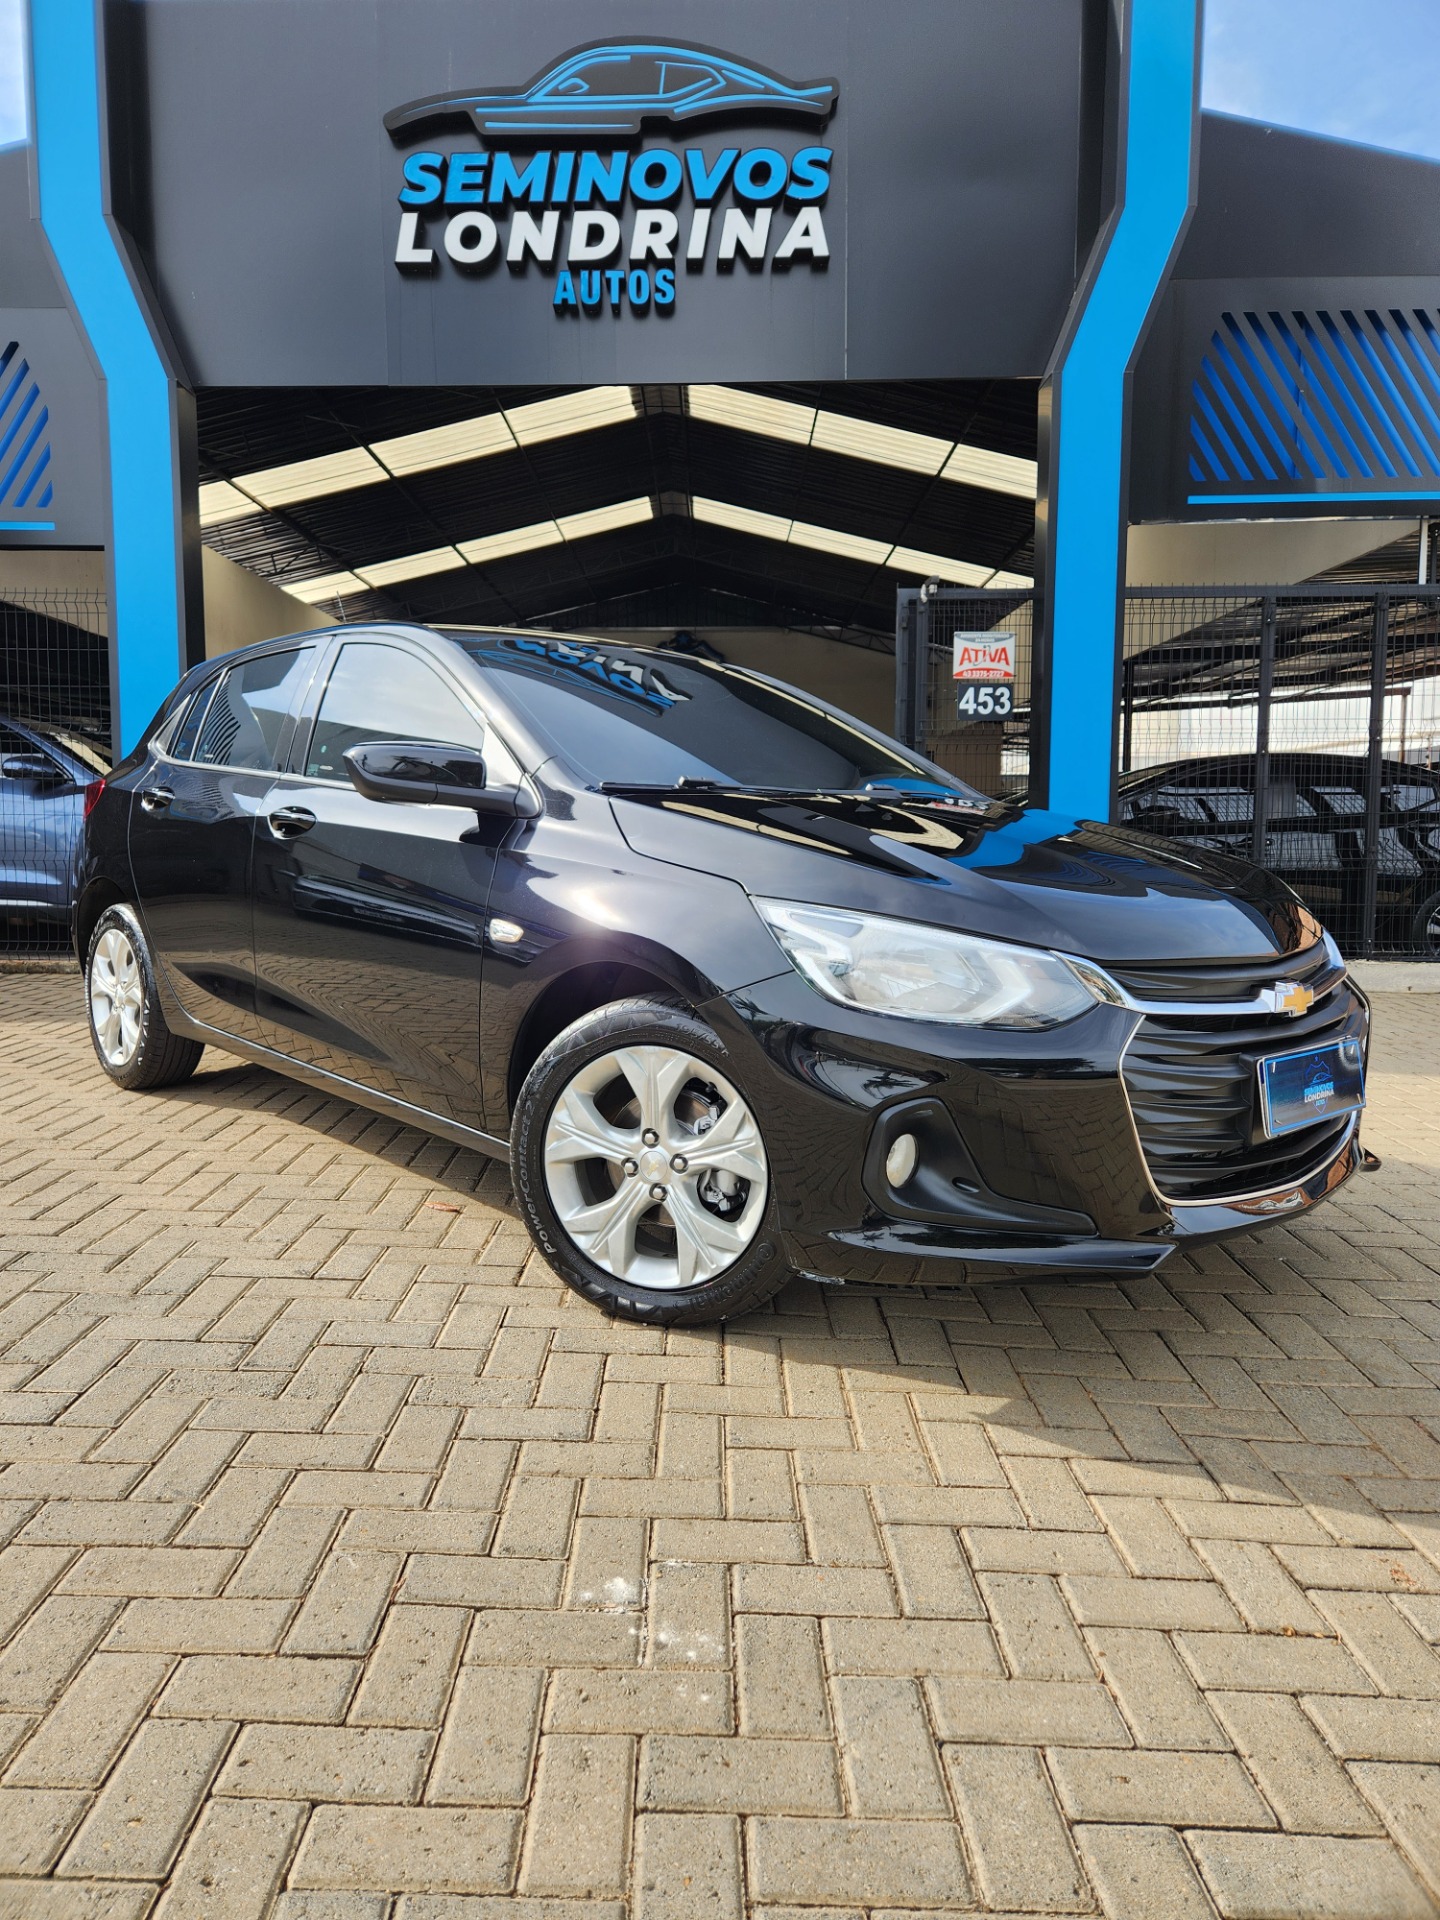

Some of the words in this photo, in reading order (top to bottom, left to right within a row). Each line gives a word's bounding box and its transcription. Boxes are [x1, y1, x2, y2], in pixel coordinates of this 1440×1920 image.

[397, 146, 834, 206] SEMINOVOS
[395, 206, 830, 265] LONDRINA
[552, 268, 676, 306] AUTOS
[958, 646, 1011, 667] ATIVA
[958, 686, 1012, 715] 453
[1304, 1088, 1335, 1103] LONDRINA
[519, 1114, 558, 1255] PowerContact
